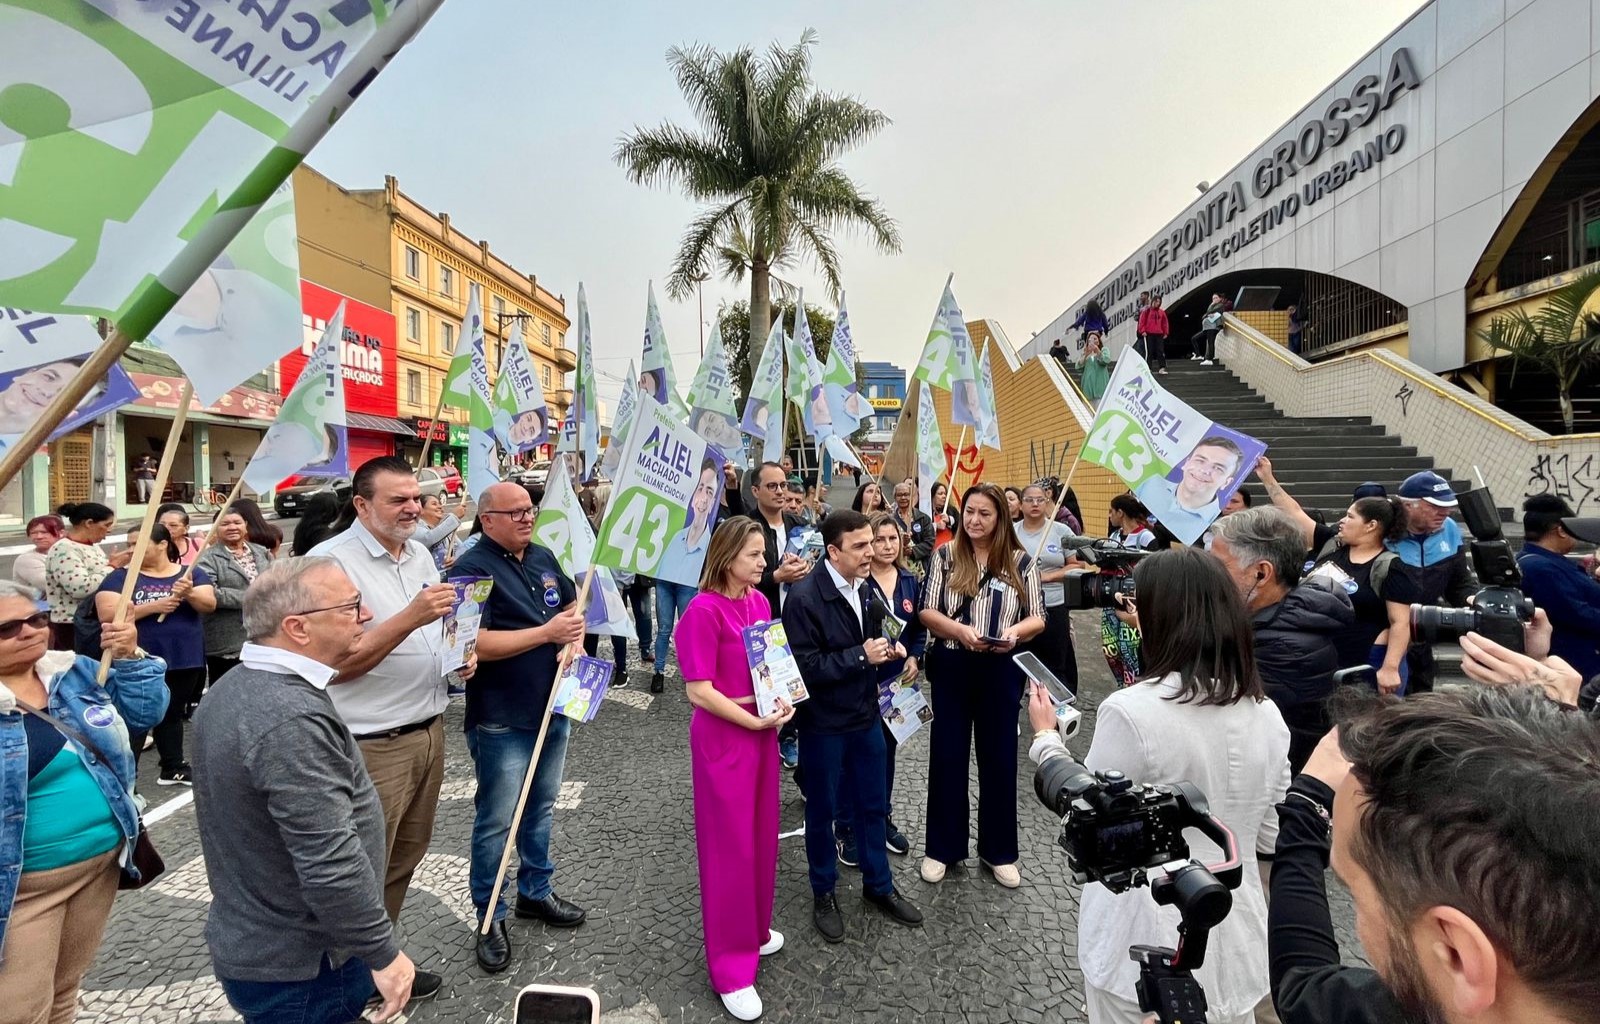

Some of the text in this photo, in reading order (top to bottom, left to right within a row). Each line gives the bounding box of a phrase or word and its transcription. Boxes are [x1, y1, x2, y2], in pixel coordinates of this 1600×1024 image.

[1145, 238, 1169, 280] DE
[1170, 181, 1246, 262] PONTA
[1252, 47, 1421, 198] GROSSA
[1220, 193, 1300, 259] COLETIVO
[1303, 124, 1404, 206] URBANO
[341, 364, 384, 387] CALÇADOS
[508, 343, 534, 400] ALIEL
[653, 408, 676, 431] Prefeito
[1124, 375, 1183, 444] ALIEL
[636, 452, 680, 485] MACHADO
[641, 425, 693, 478] ALIEL
[1087, 414, 1153, 483] 43
[642, 473, 665, 491] LILIANE
[608, 492, 670, 572] 43
[474, 584, 491, 597] 43
[772, 627, 785, 640] 43
[886, 621, 898, 636] 43
